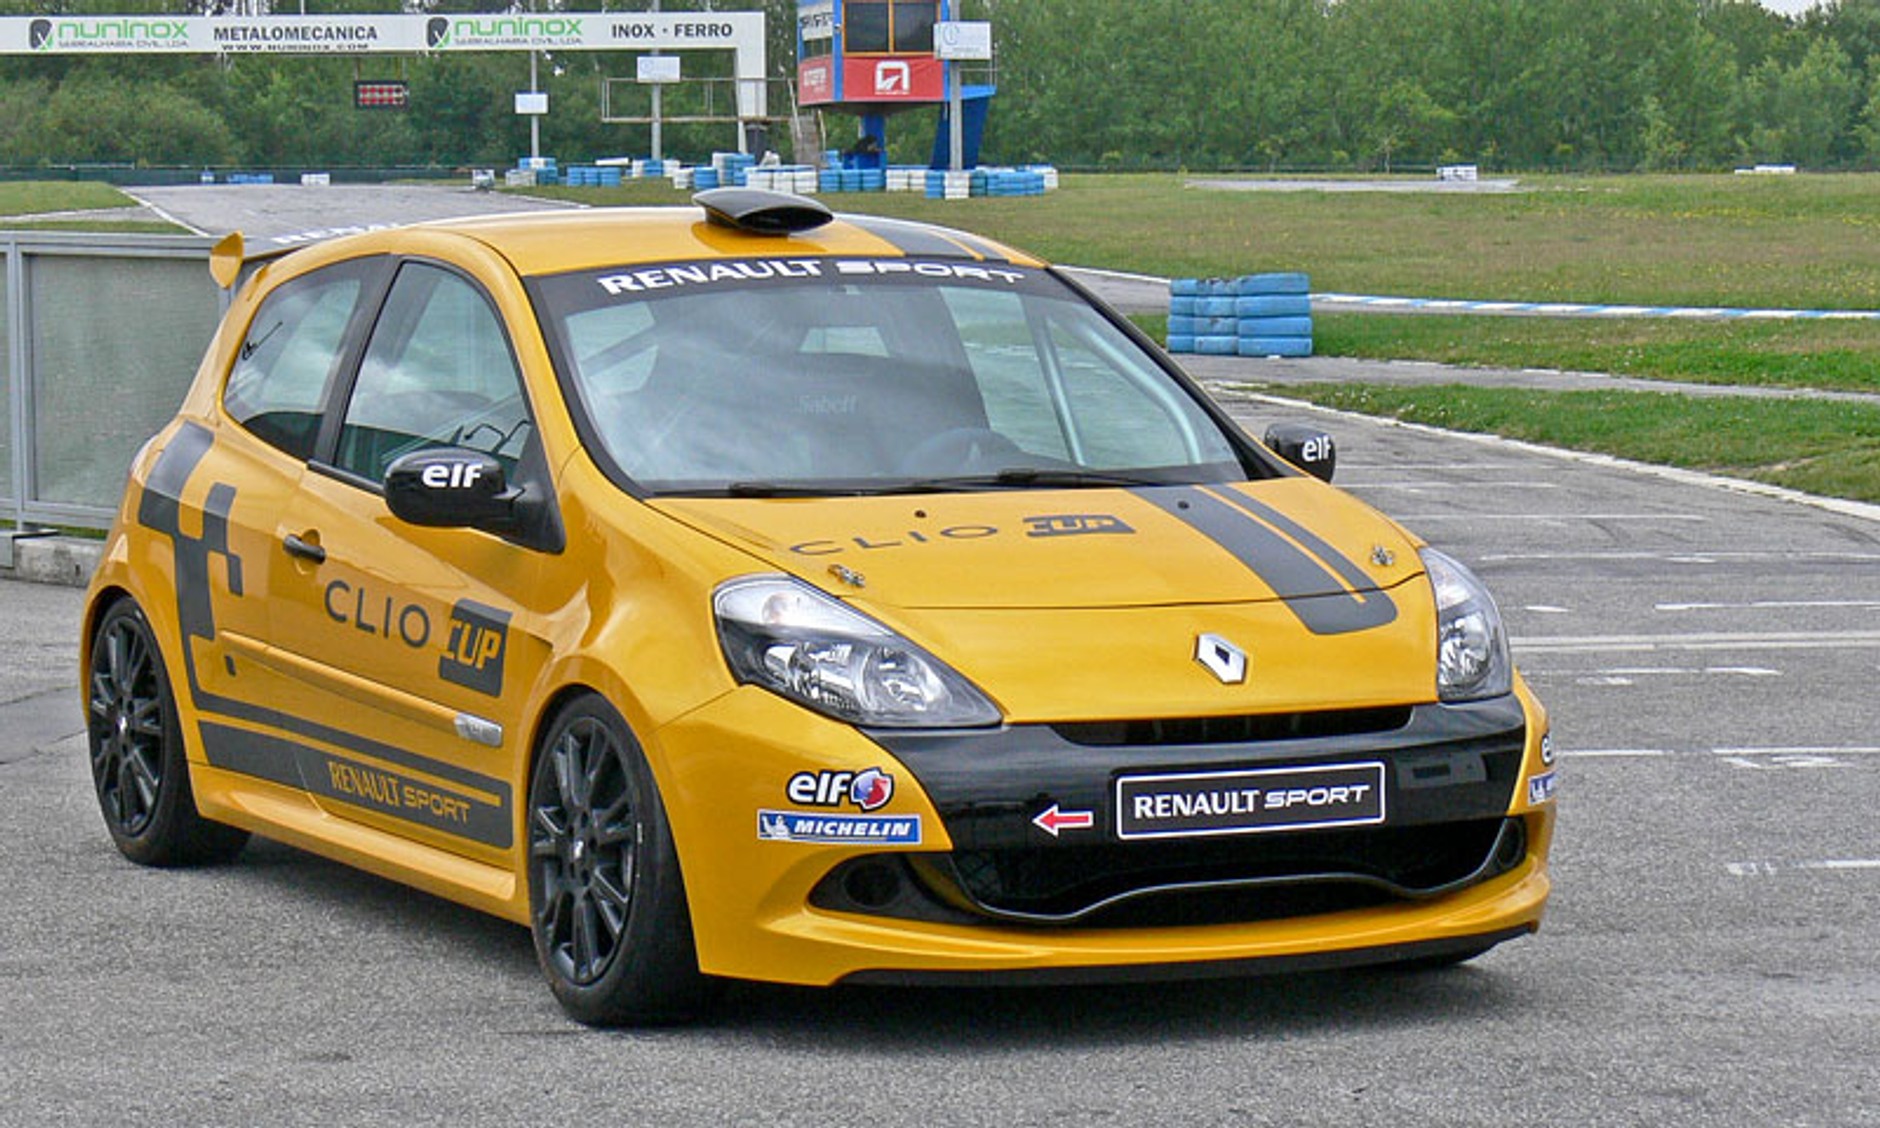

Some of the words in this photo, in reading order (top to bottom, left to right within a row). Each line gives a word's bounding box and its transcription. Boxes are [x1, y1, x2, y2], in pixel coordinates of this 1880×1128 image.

[58, 19, 189, 39] nuninox
[455, 17, 583, 36] nuninox
[612, 23, 656, 38] INOX
[674, 23, 734, 38] FERRO
[597, 260, 821, 296] RENAULT
[836, 260, 1026, 286] SPORT
[1301, 434, 1332, 463] elf
[422, 463, 484, 488] elf
[790, 525, 999, 556] CLIO
[1022, 514, 1128, 538] CUP
[324, 579, 431, 649] CLIO
[441, 617, 503, 671] CUP
[327, 760, 401, 808] RENAULT
[403, 784, 471, 824] SPORT
[787, 771, 852, 806] elf
[1133, 788, 1261, 820] RENAULT
[1263, 784, 1370, 809] SPORT
[794, 819, 912, 837] MICHELIN
